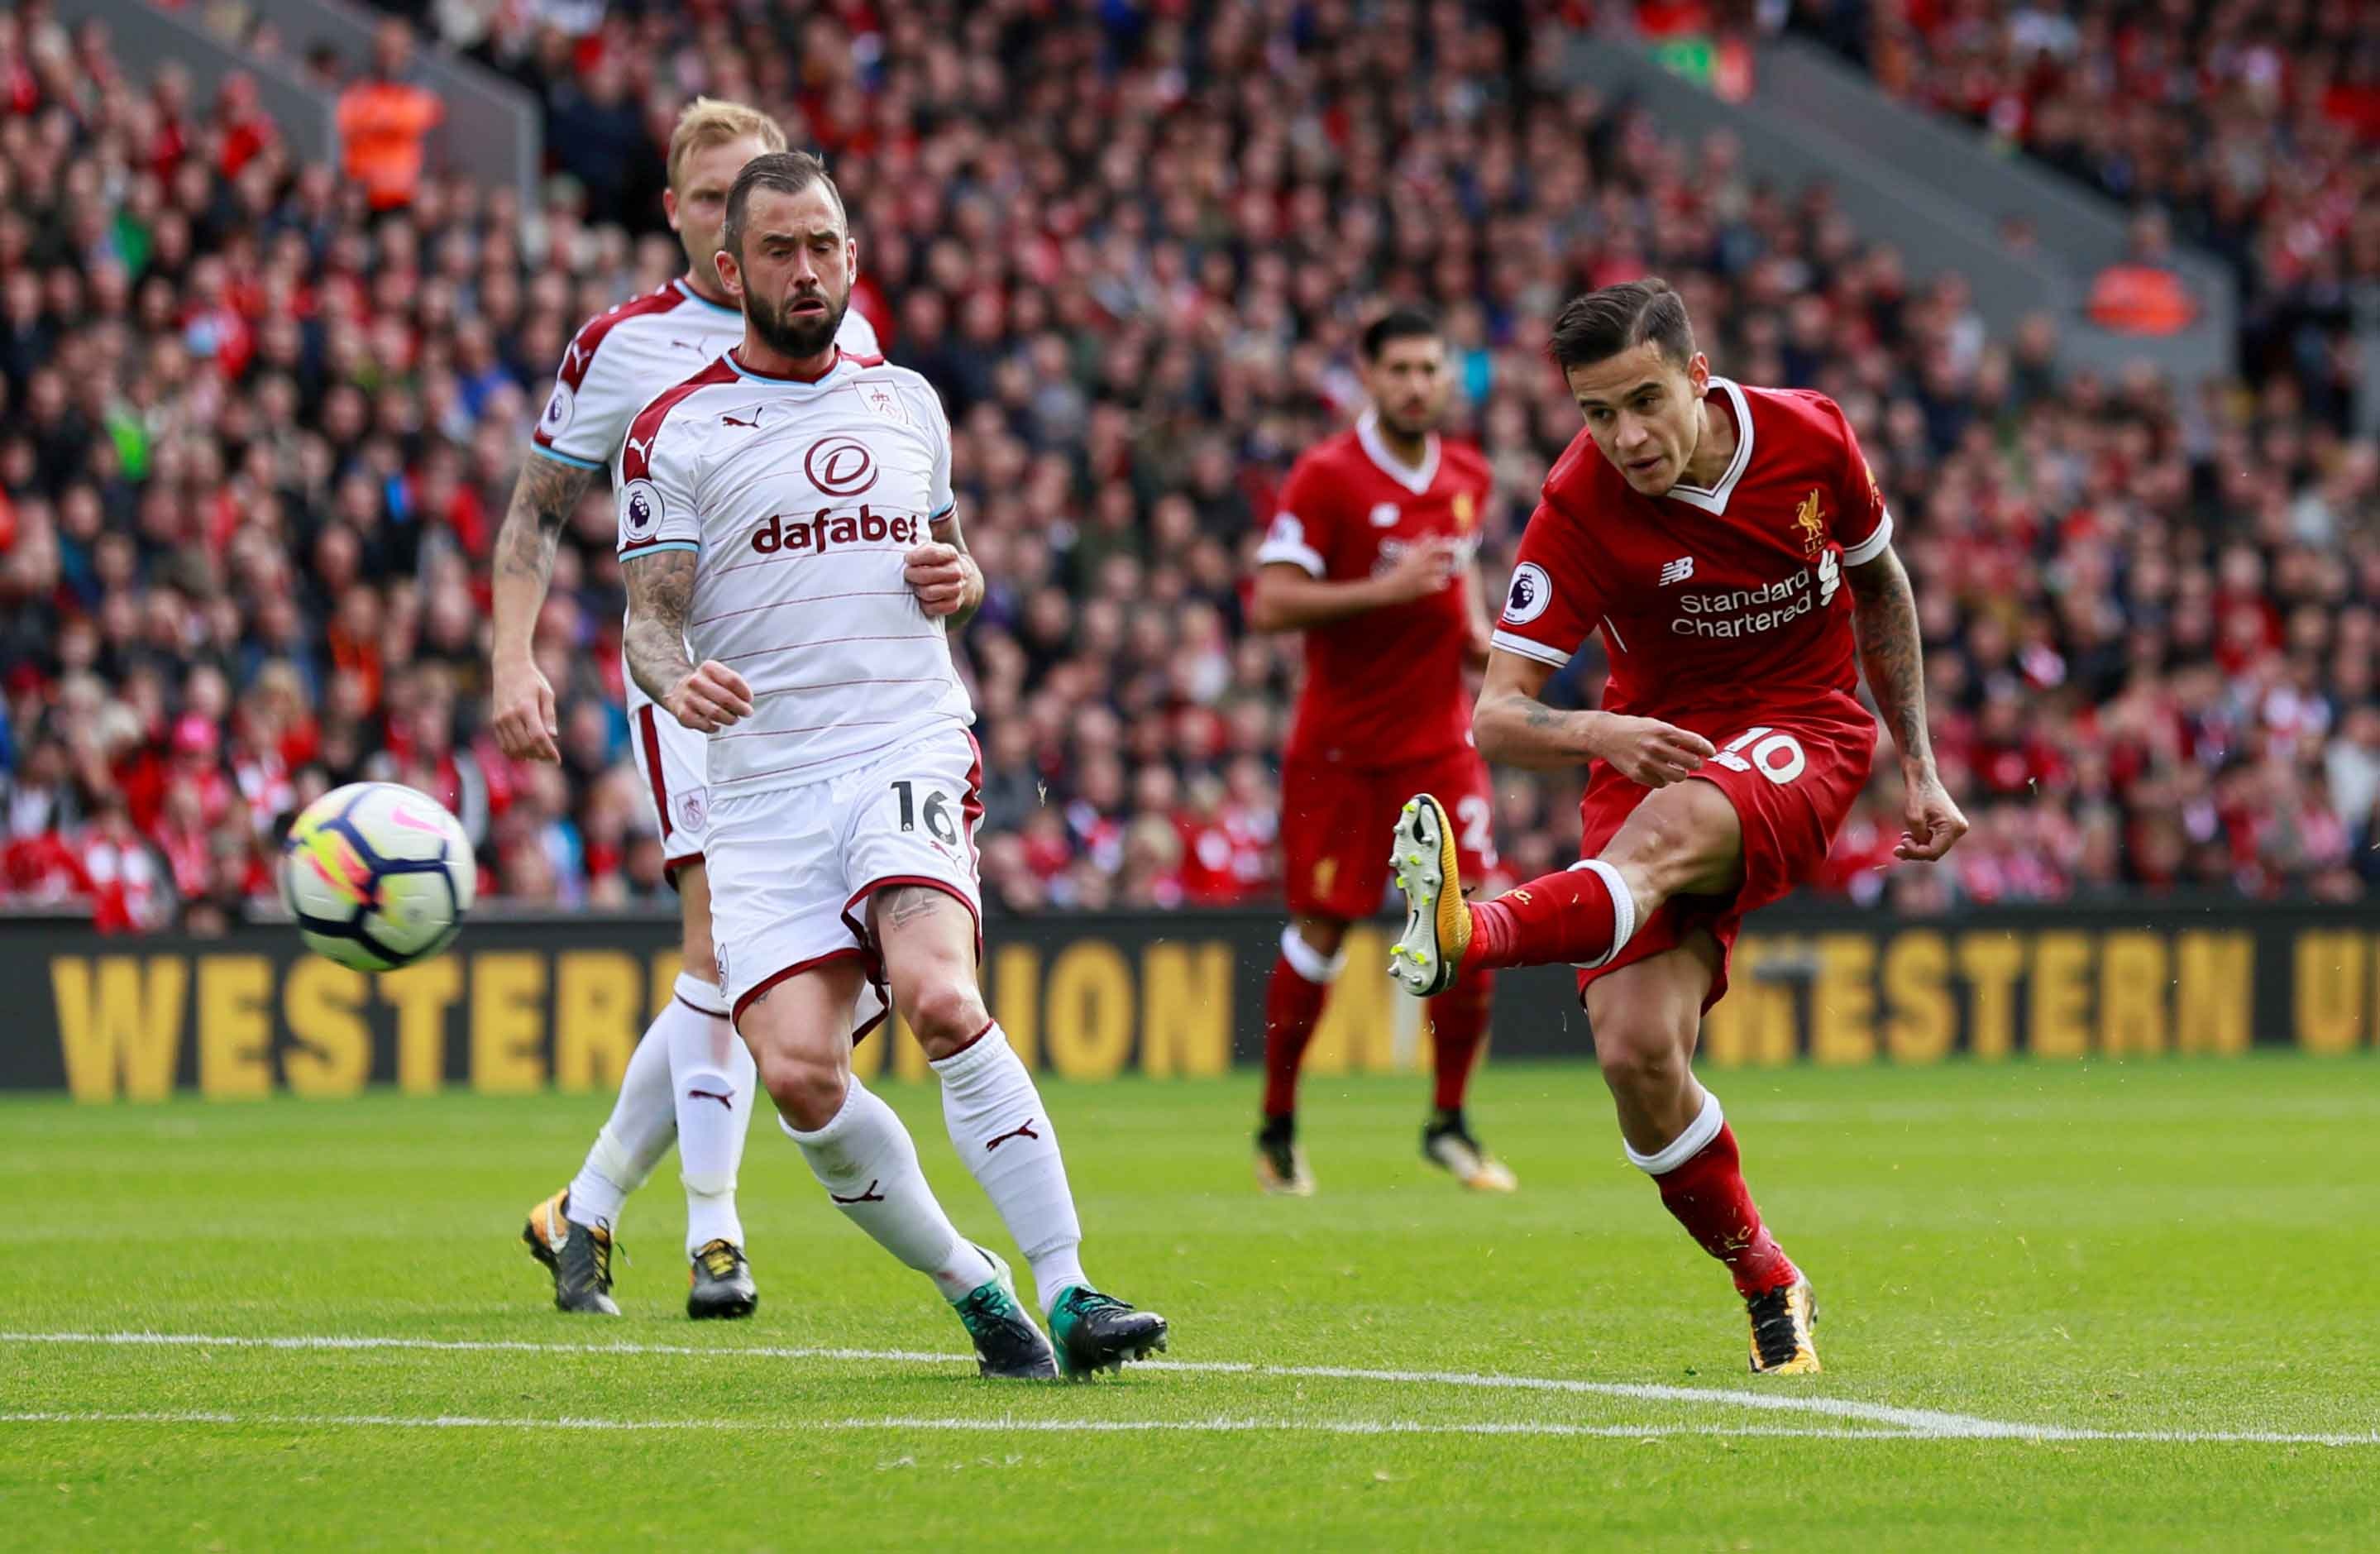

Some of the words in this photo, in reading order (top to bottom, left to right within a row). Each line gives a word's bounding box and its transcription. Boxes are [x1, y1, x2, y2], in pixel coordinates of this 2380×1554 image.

[751, 503, 918, 554] dafabet
[1671, 590, 1812, 638] Chartered
[1680, 567, 1810, 614] Standard
[1723, 727, 1806, 784] 10
[891, 781, 957, 846] 16
[852, 940, 1234, 1082] ION
[2291, 926, 2380, 1055] U
